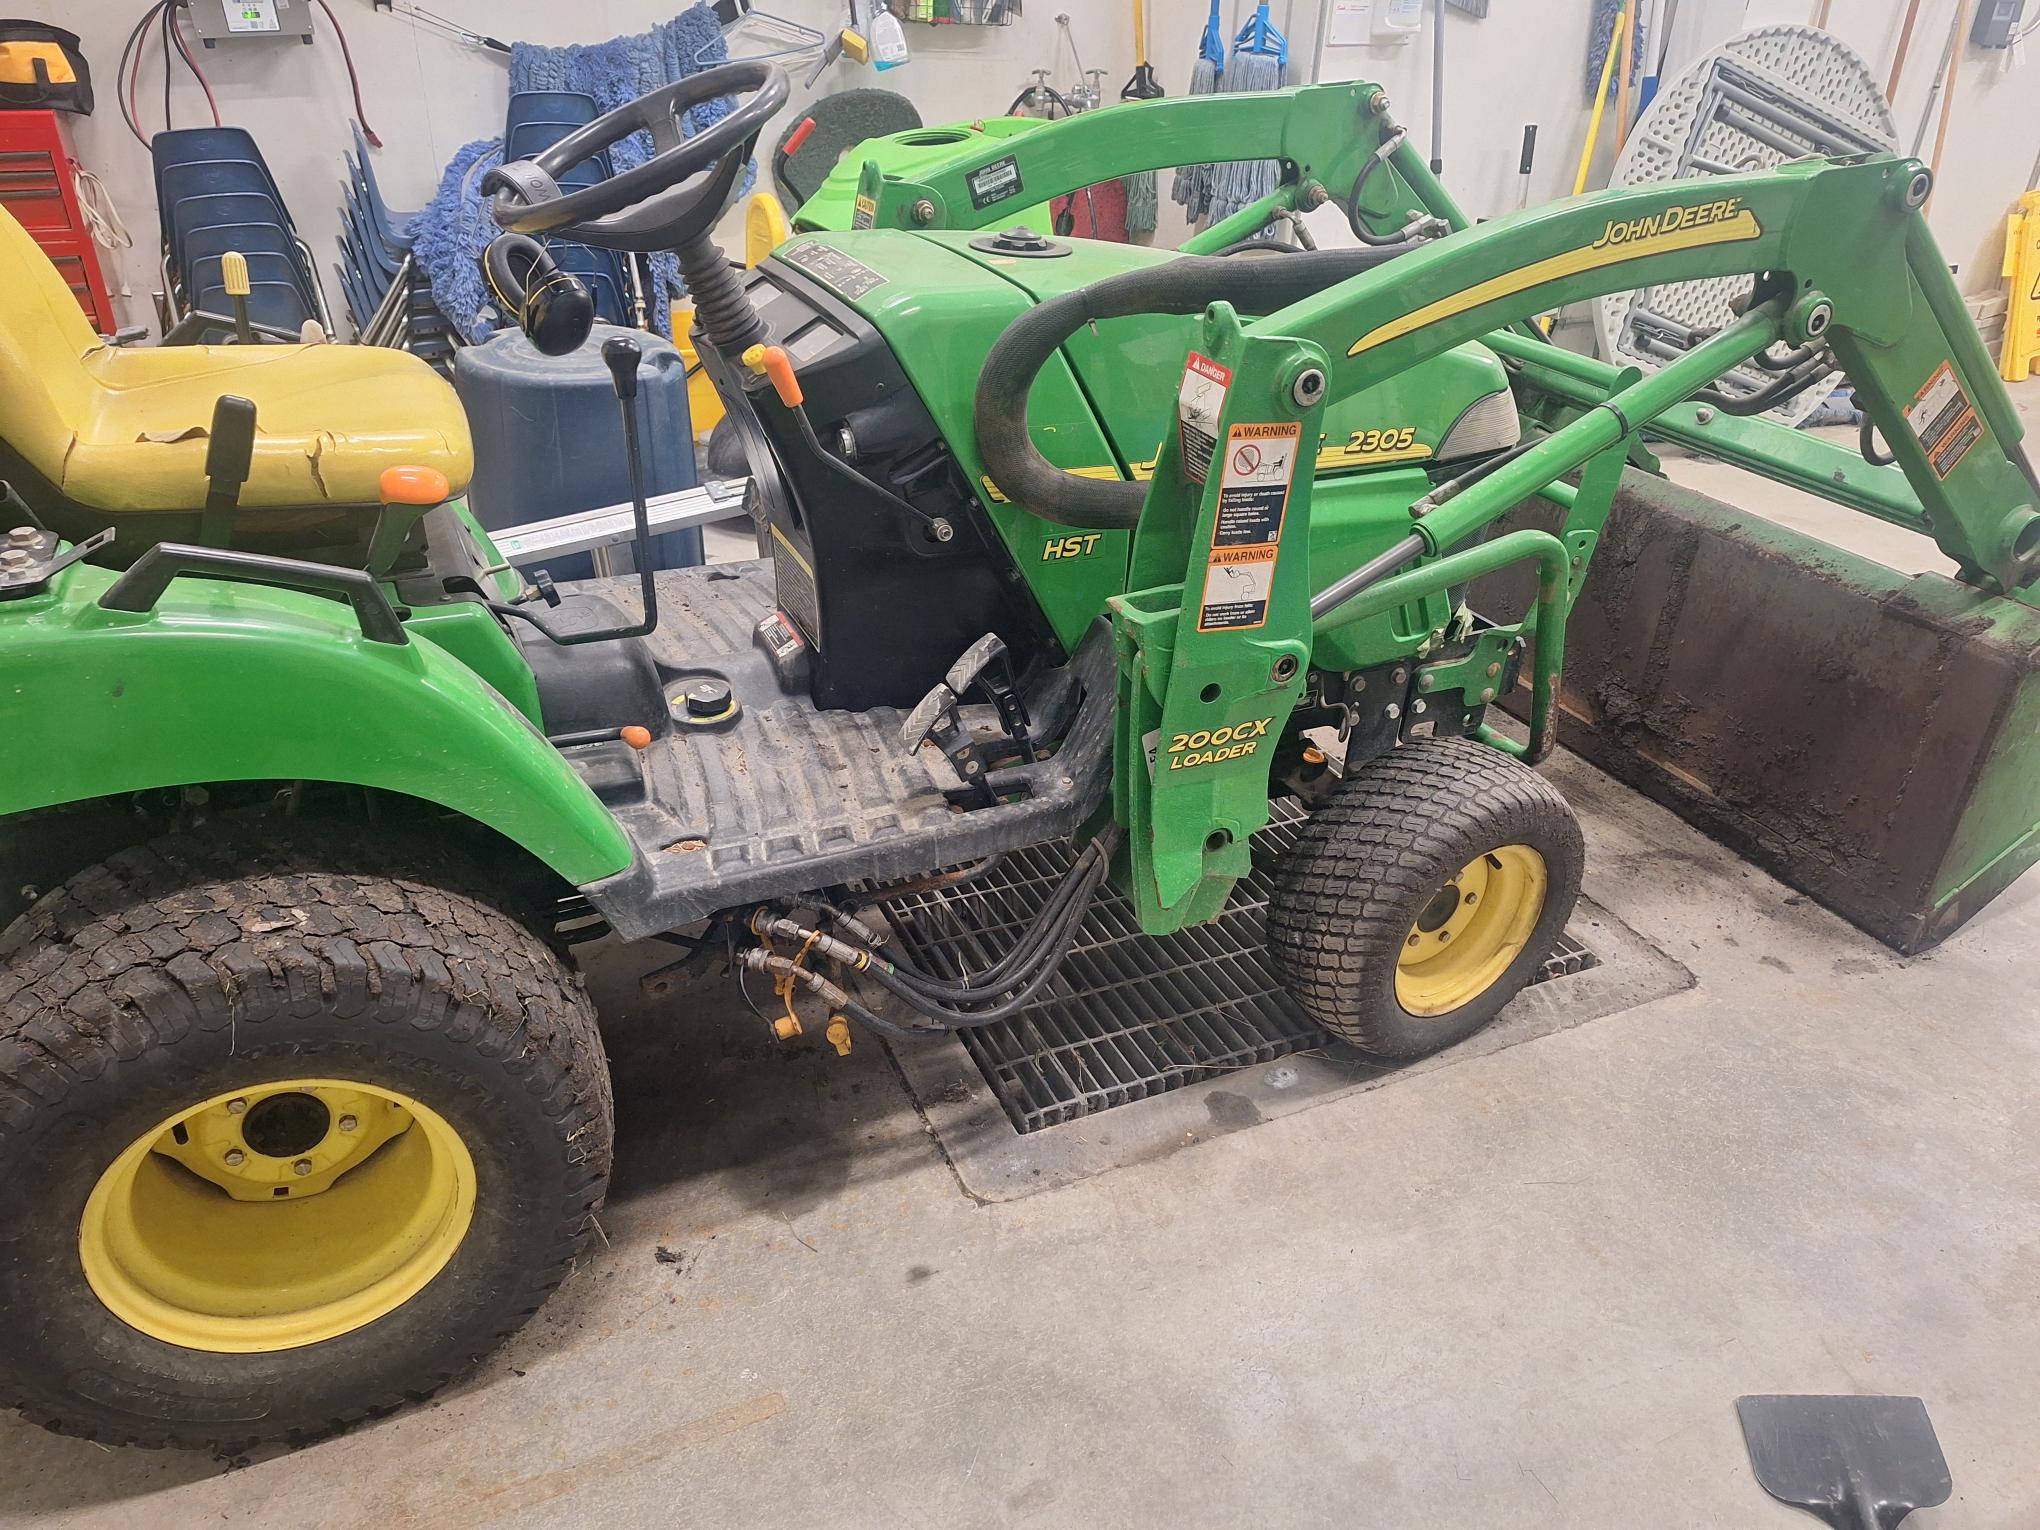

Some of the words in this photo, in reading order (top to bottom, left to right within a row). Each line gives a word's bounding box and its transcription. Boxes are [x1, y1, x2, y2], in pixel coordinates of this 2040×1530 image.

[1592, 213, 1661, 249] JOHN
[1660, 196, 1744, 234] DEERE
[1200, 362, 1226, 382] DANGER
[1243, 425, 1297, 438] WARNING
[1344, 427, 1416, 454] 2305
[1042, 533, 1102, 561] HST
[1223, 549, 1274, 562] WARNING
[1168, 717, 1275, 753] 200CX
[1169, 741, 1258, 770] LOADER
